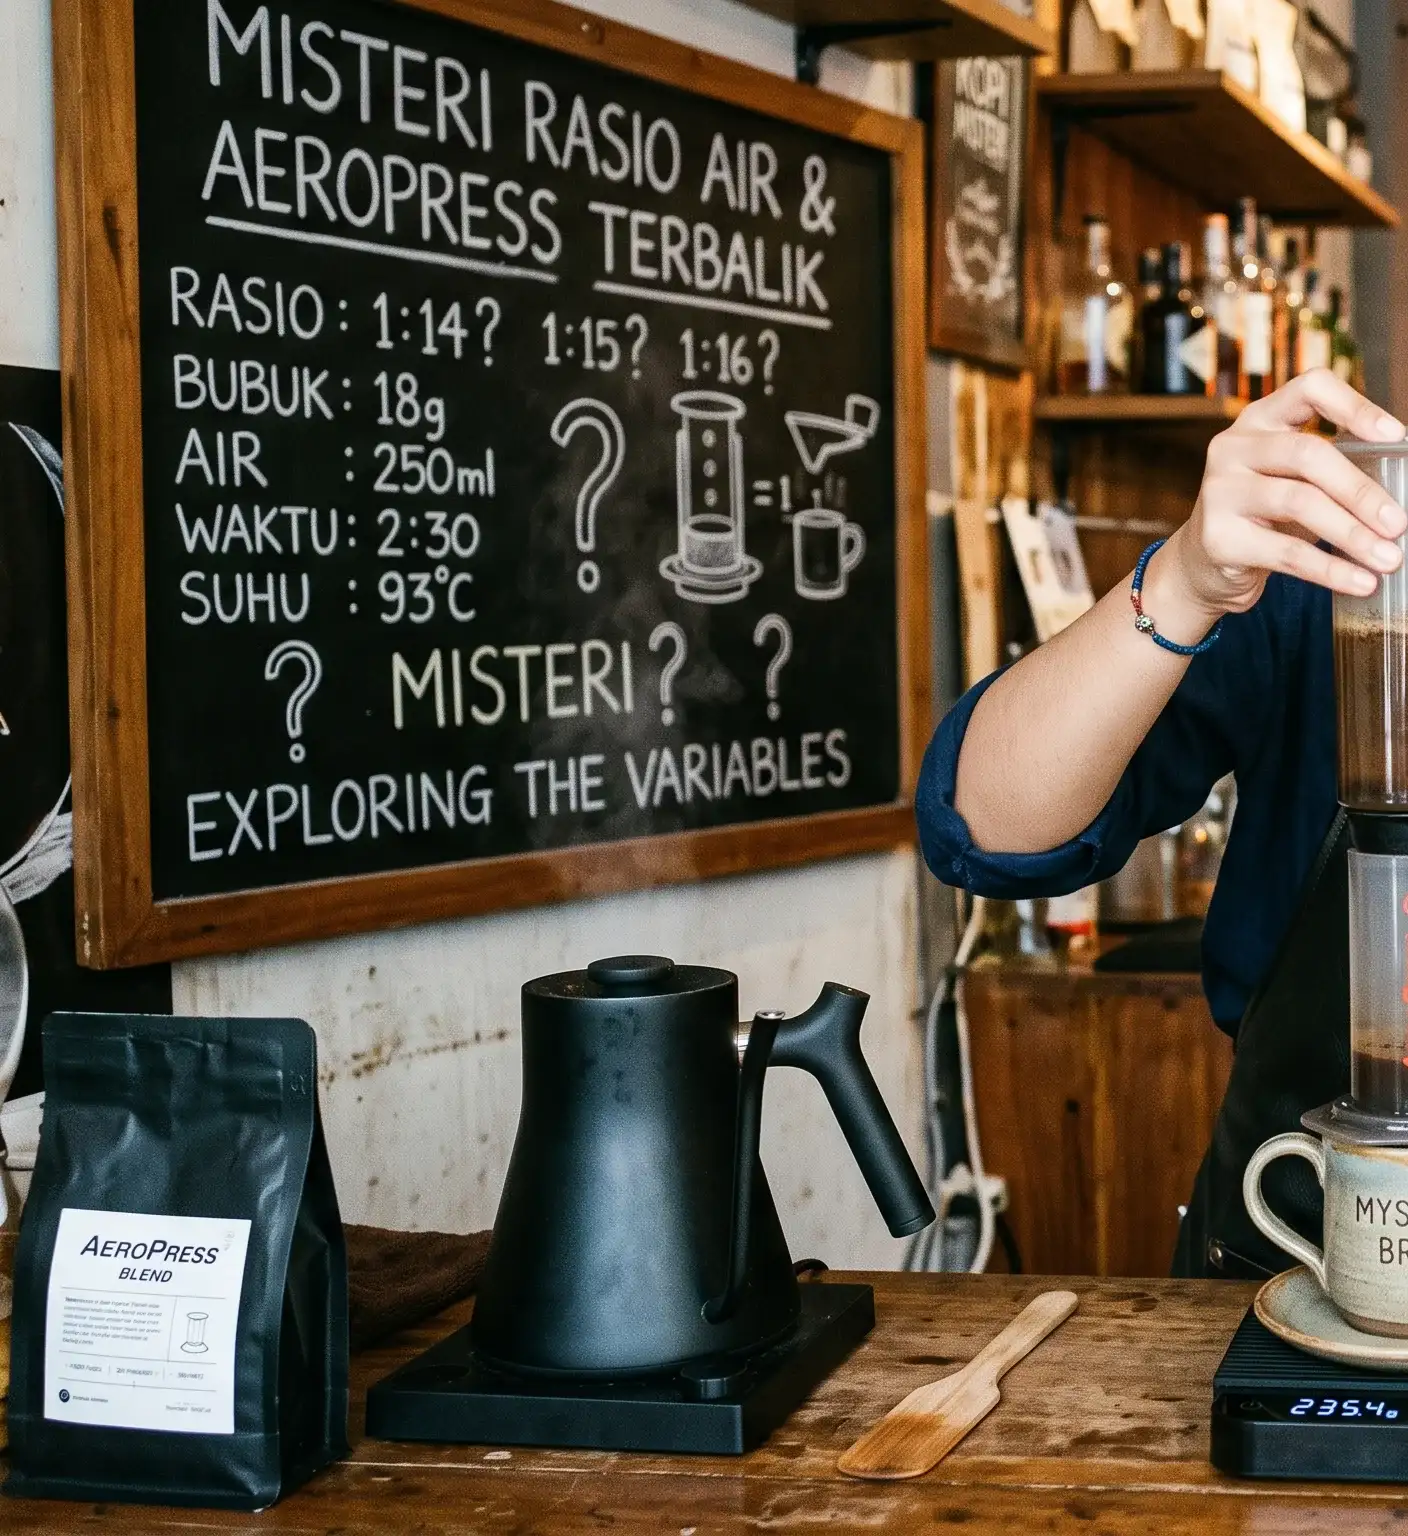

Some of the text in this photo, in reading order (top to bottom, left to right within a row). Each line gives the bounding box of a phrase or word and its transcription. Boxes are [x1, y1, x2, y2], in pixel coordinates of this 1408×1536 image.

[207, 3, 836, 235] MISTERI RASIO AIR &
[201, 119, 828, 311] AEROPRESS TERBALIK
[373, 292, 501, 367] 1:14?
[542, 312, 648, 380] 1:15?
[680, 328, 780, 395] 1:16?
[374, 371, 445, 442] 18g
[175, 427, 268, 487] AIR
[373, 442, 495, 496] 250ml
[377, 508, 480, 559] 2:30
[180, 570, 310, 625] SUHU
[378, 565, 475, 624] 93°C
[186, 729, 849, 862] EXPLORING THE VARIABLES
[118, 1267, 173, 1283] BLEND
